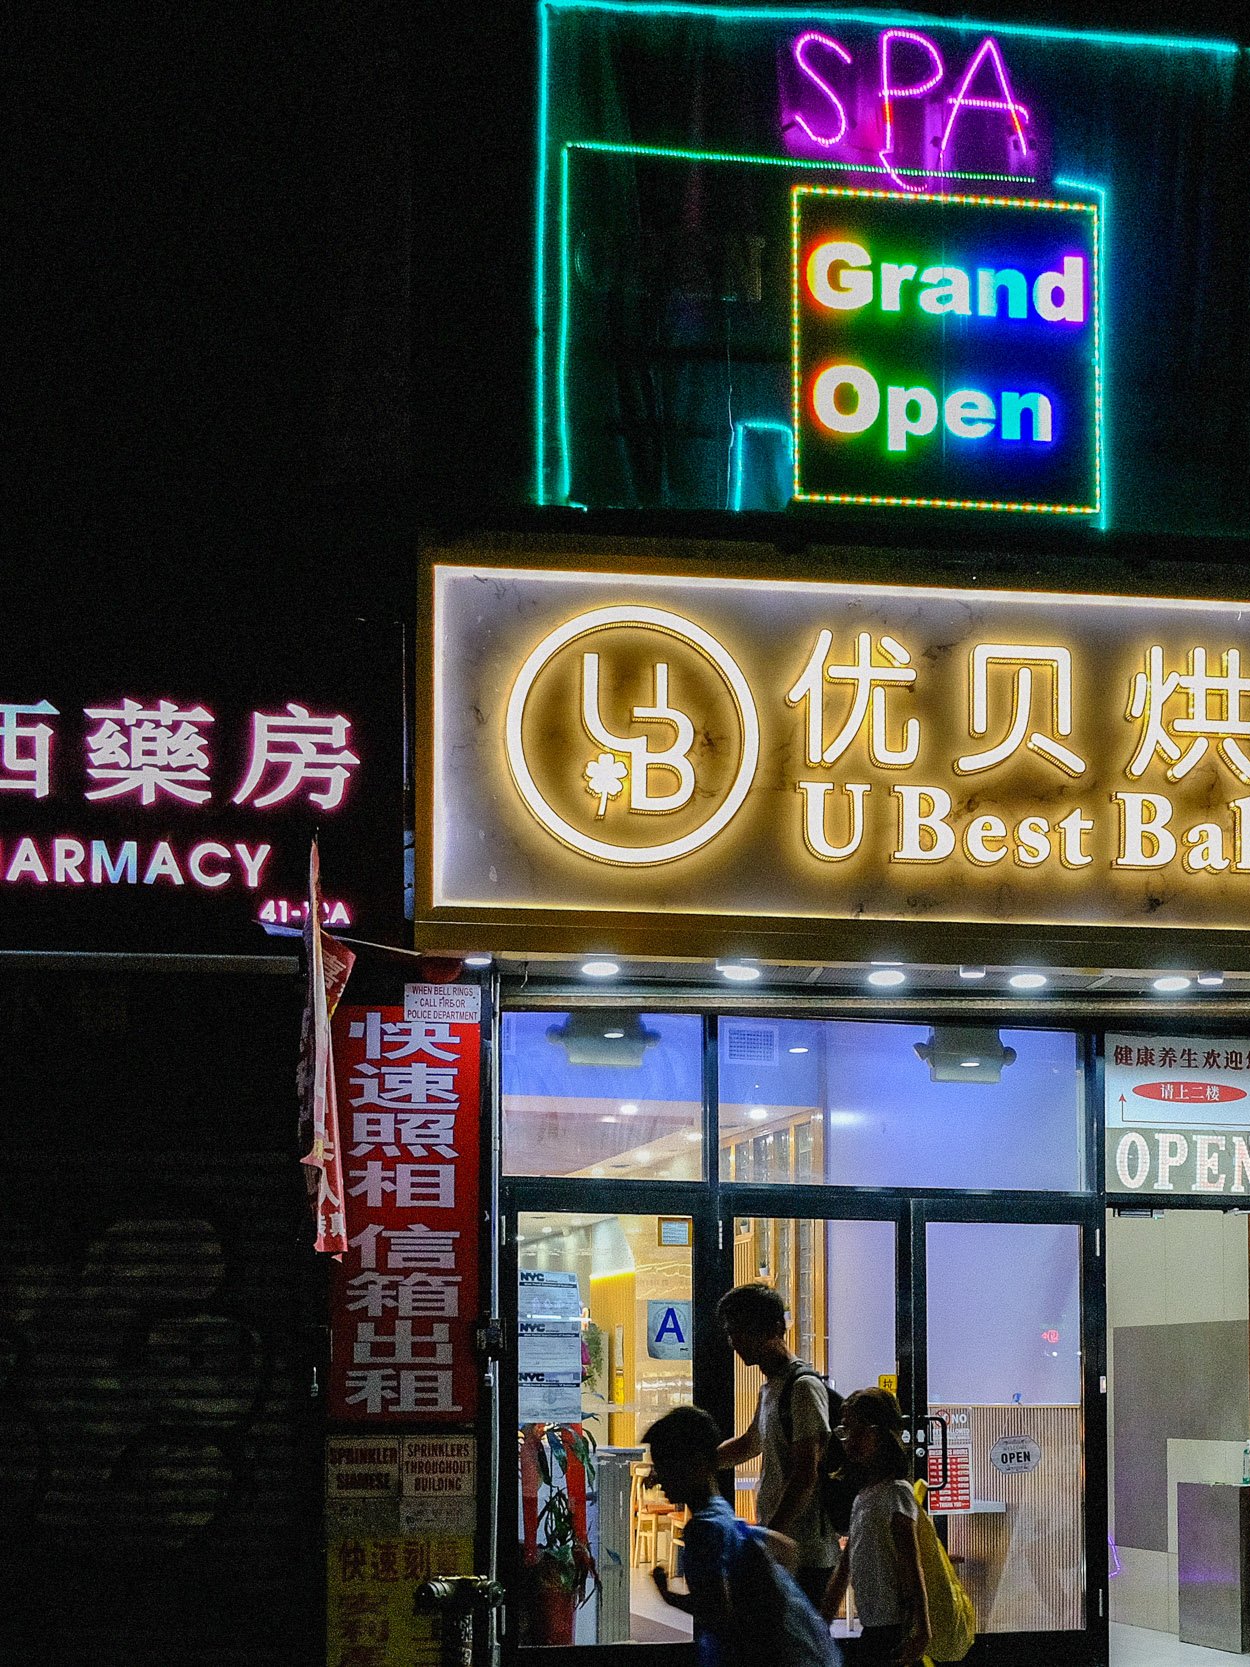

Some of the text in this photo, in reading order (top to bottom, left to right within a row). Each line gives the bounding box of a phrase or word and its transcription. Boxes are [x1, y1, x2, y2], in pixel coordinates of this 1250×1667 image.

[793, 29, 1030, 160] SPA
[806, 240, 1086, 323] Grand
[811, 363, 1053, 451] Open
[798, 779, 874, 862] U
[892, 783, 1095, 870] Best
[411, 985, 474, 997] WHEN BELL RINGS
[419, 997, 466, 1008] CALL FIRE OR
[407, 1009, 478, 1021] POLICE DEPARTMENT
[1159, 1083, 1221, 1102] 请上二楼
[347, 1011, 462, 1209] 快速照相
[520, 1271, 545, 1282] NYC
[345, 1223, 463, 1415] 信箱出租
[654, 1307, 685, 1343] A
[519, 1323, 546, 1333] NYC
[519, 1373, 545, 1382] NYC
[951, 1413, 967, 1424] NO
[329, 1446, 398, 1465] SPRINKLER
[407, 1443, 470, 1458] SPRINKLERS
[1001, 1450, 1031, 1464] OPEN
[404, 1460, 473, 1475] THROUGHOUT
[414, 1477, 462, 1492] BUILDING
